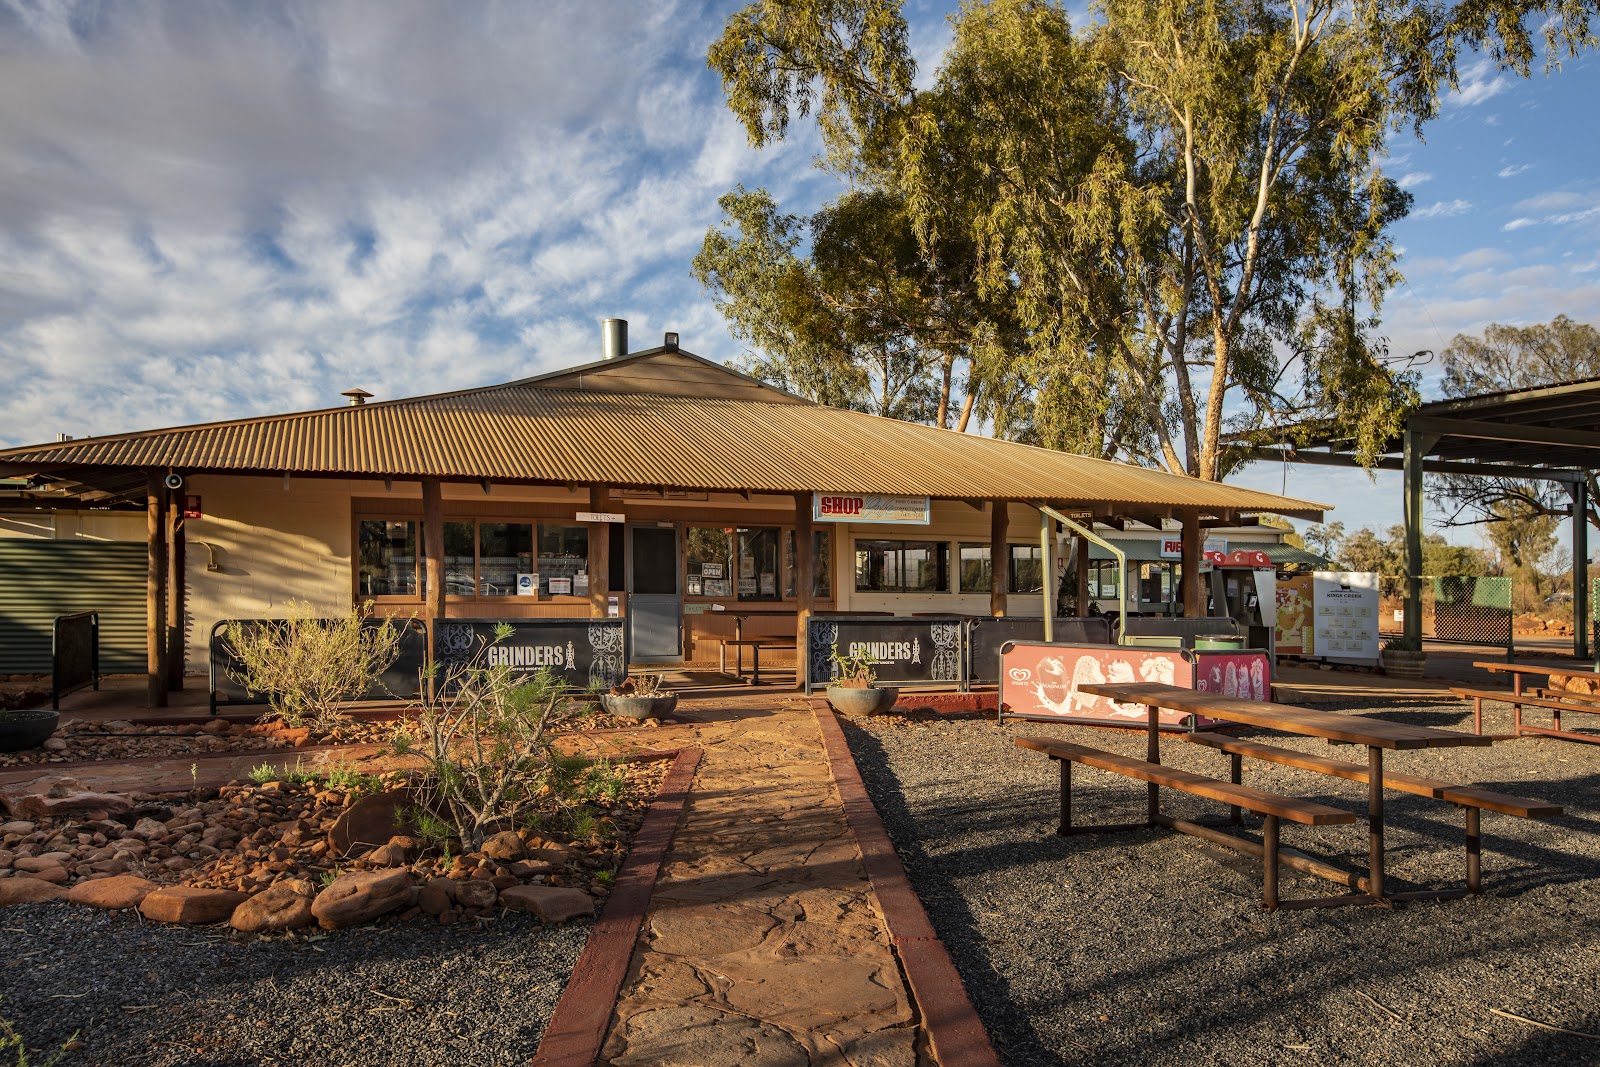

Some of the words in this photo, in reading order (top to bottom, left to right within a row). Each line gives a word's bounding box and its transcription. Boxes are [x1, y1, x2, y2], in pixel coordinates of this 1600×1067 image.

[821, 496, 864, 515] SHOP
[590, 513, 611, 521] TOILETS
[703, 568, 721, 576] OPEN
[488, 645, 564, 666] GRINDERS
[849, 641, 912, 660] GRINDERS
[1042, 682, 1067, 690] MAGNUM
